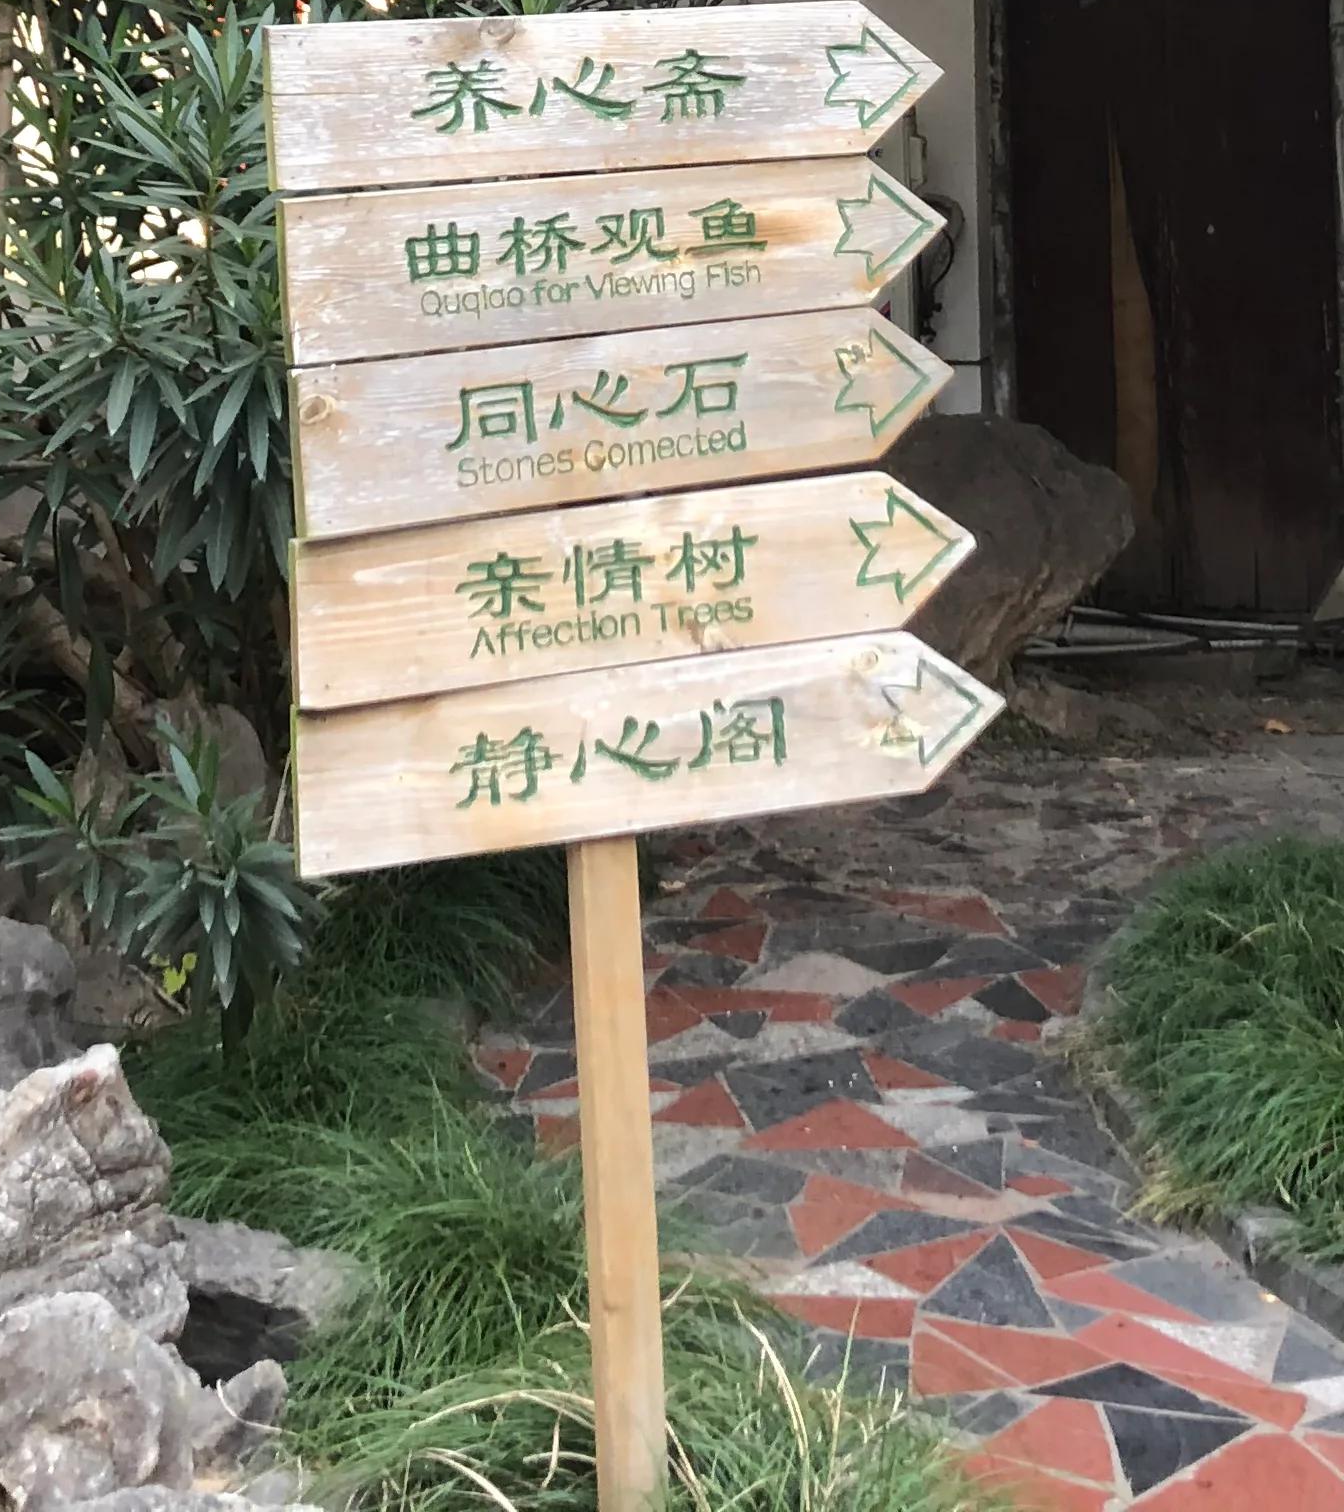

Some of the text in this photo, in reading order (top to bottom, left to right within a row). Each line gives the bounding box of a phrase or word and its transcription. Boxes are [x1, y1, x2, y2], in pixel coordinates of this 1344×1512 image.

[412, 48, 747, 133] 养心斋
[405, 198, 767, 283] 曲桥观鱼
[420, 260, 762, 319] Quqiao for Viewing Fish
[446, 353, 750, 451] 同心石
[457, 447, 574, 487] Stones
[455, 525, 759, 619] 亲情树
[469, 596, 754, 659] Affection Trees
[449, 696, 788, 808] 静心阁
